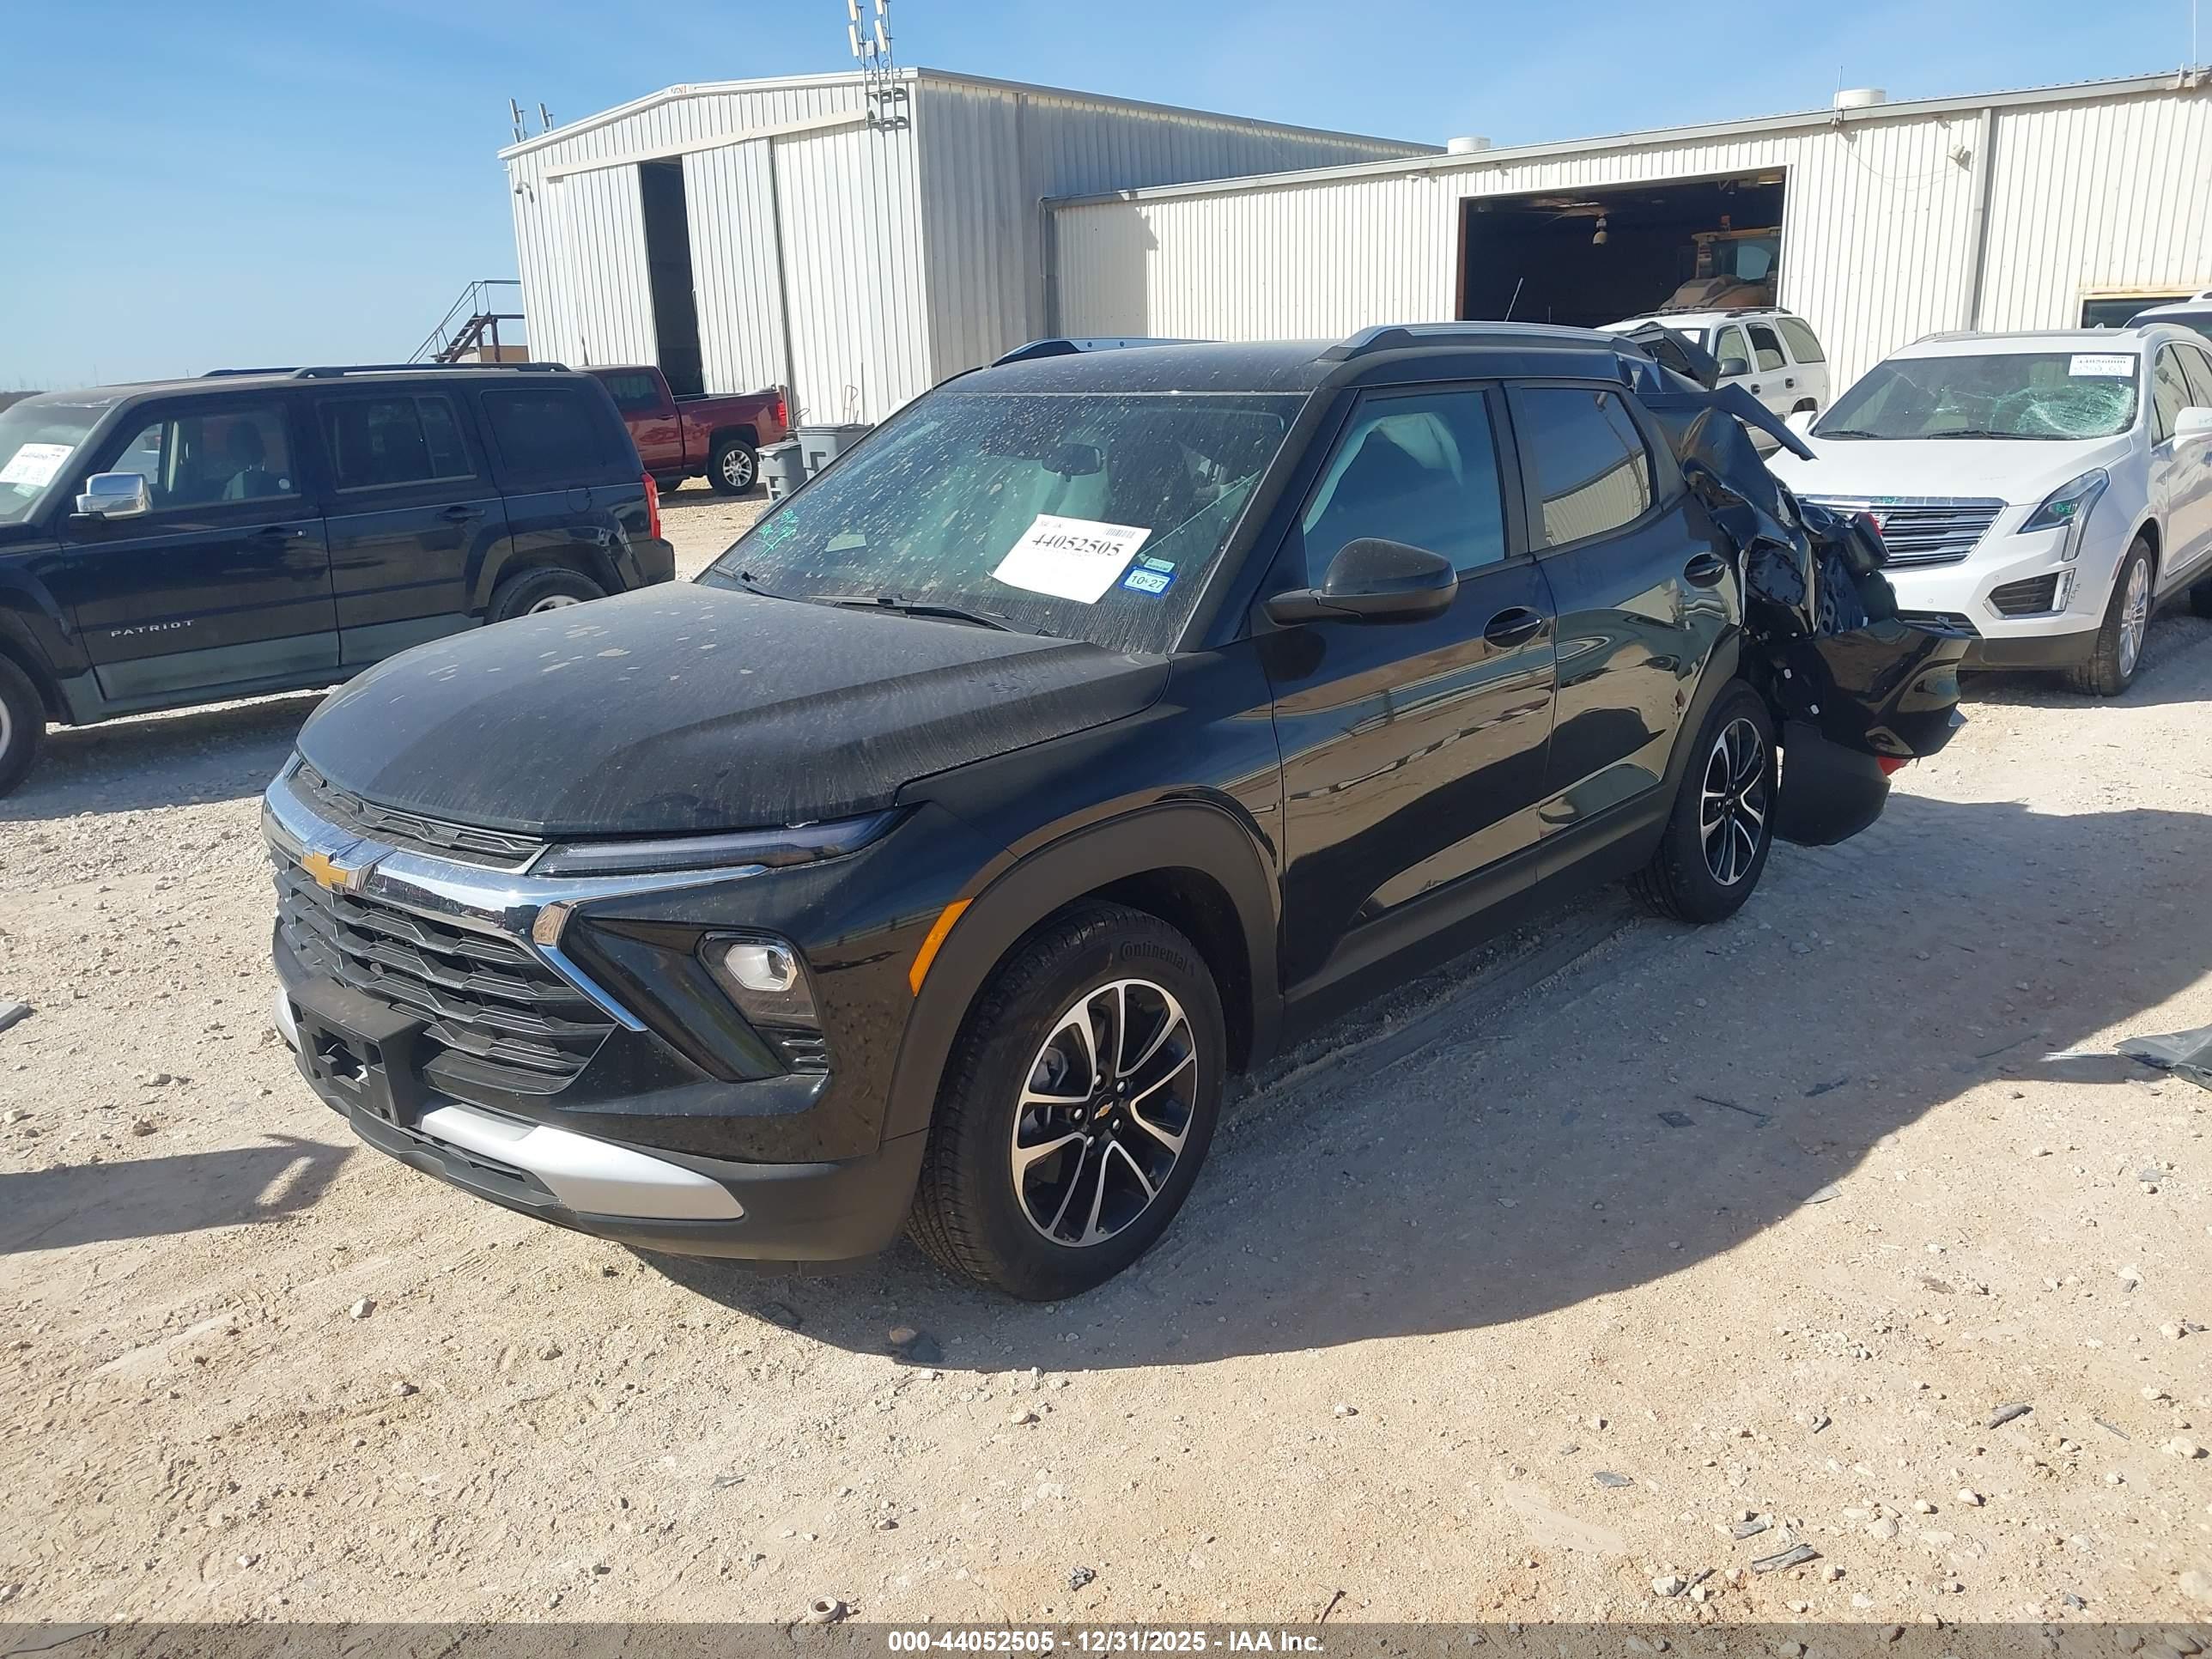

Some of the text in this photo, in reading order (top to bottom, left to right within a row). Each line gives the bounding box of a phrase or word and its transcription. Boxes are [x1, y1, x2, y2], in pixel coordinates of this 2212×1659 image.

[1032, 533, 1124, 556] 44052505
[111, 619, 194, 637] PATRIOT
[1120, 941, 1188, 973] Continental
